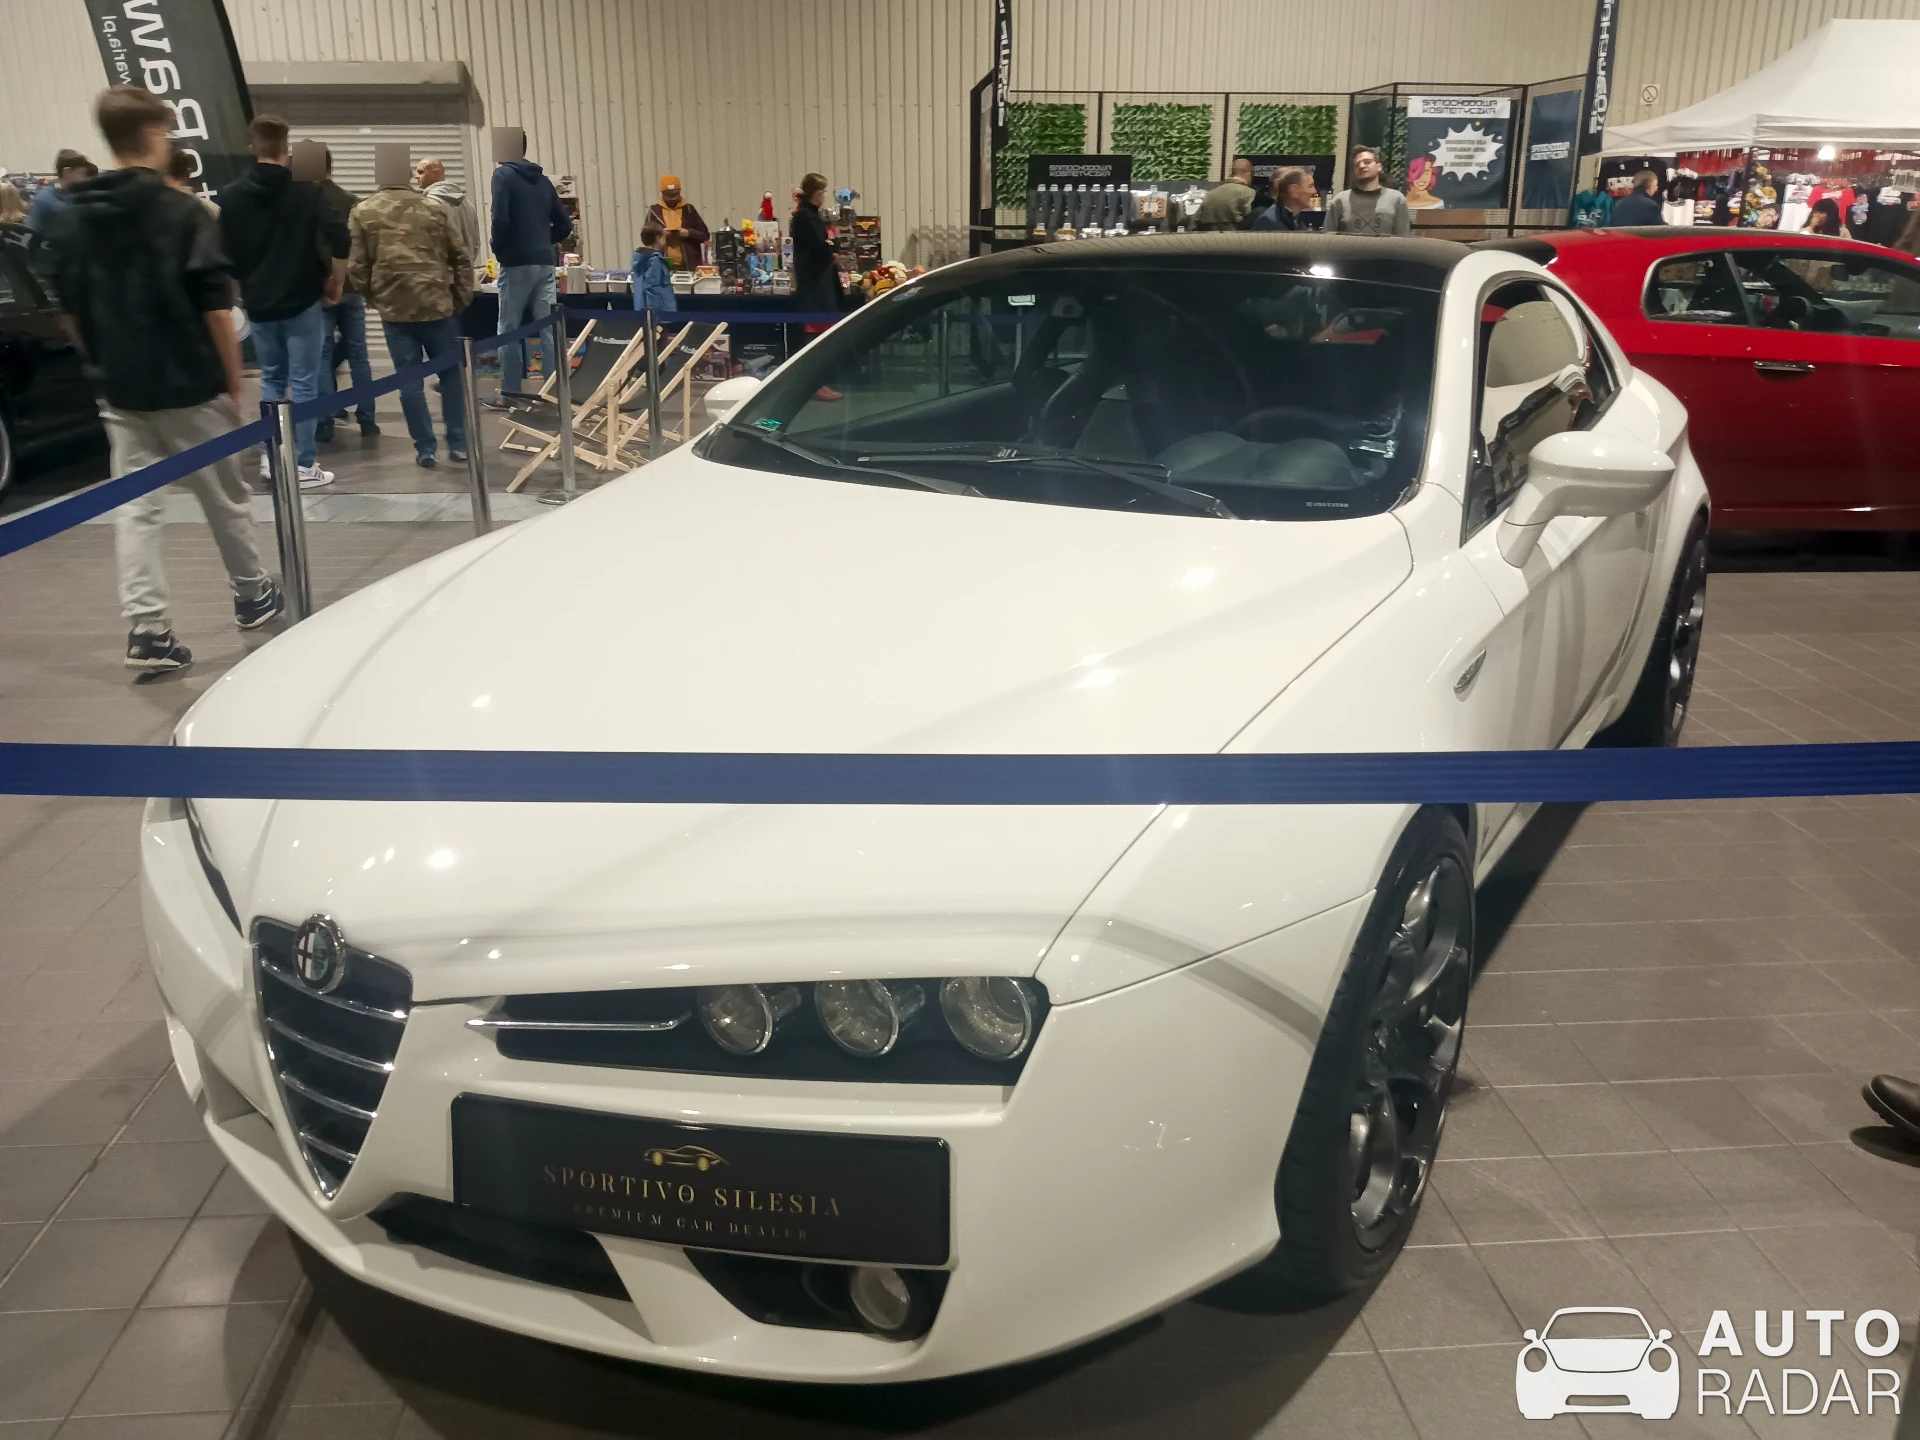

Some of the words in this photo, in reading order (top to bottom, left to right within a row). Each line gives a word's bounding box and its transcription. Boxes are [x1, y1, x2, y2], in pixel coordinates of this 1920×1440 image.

[544, 1164, 695, 1204] SPORTIVO
[714, 1187, 840, 1216] SILESIA
[573, 1202, 662, 1226] PREMIUM
[676, 1216, 713, 1232] CAR
[729, 1222, 807, 1240] DEALER
